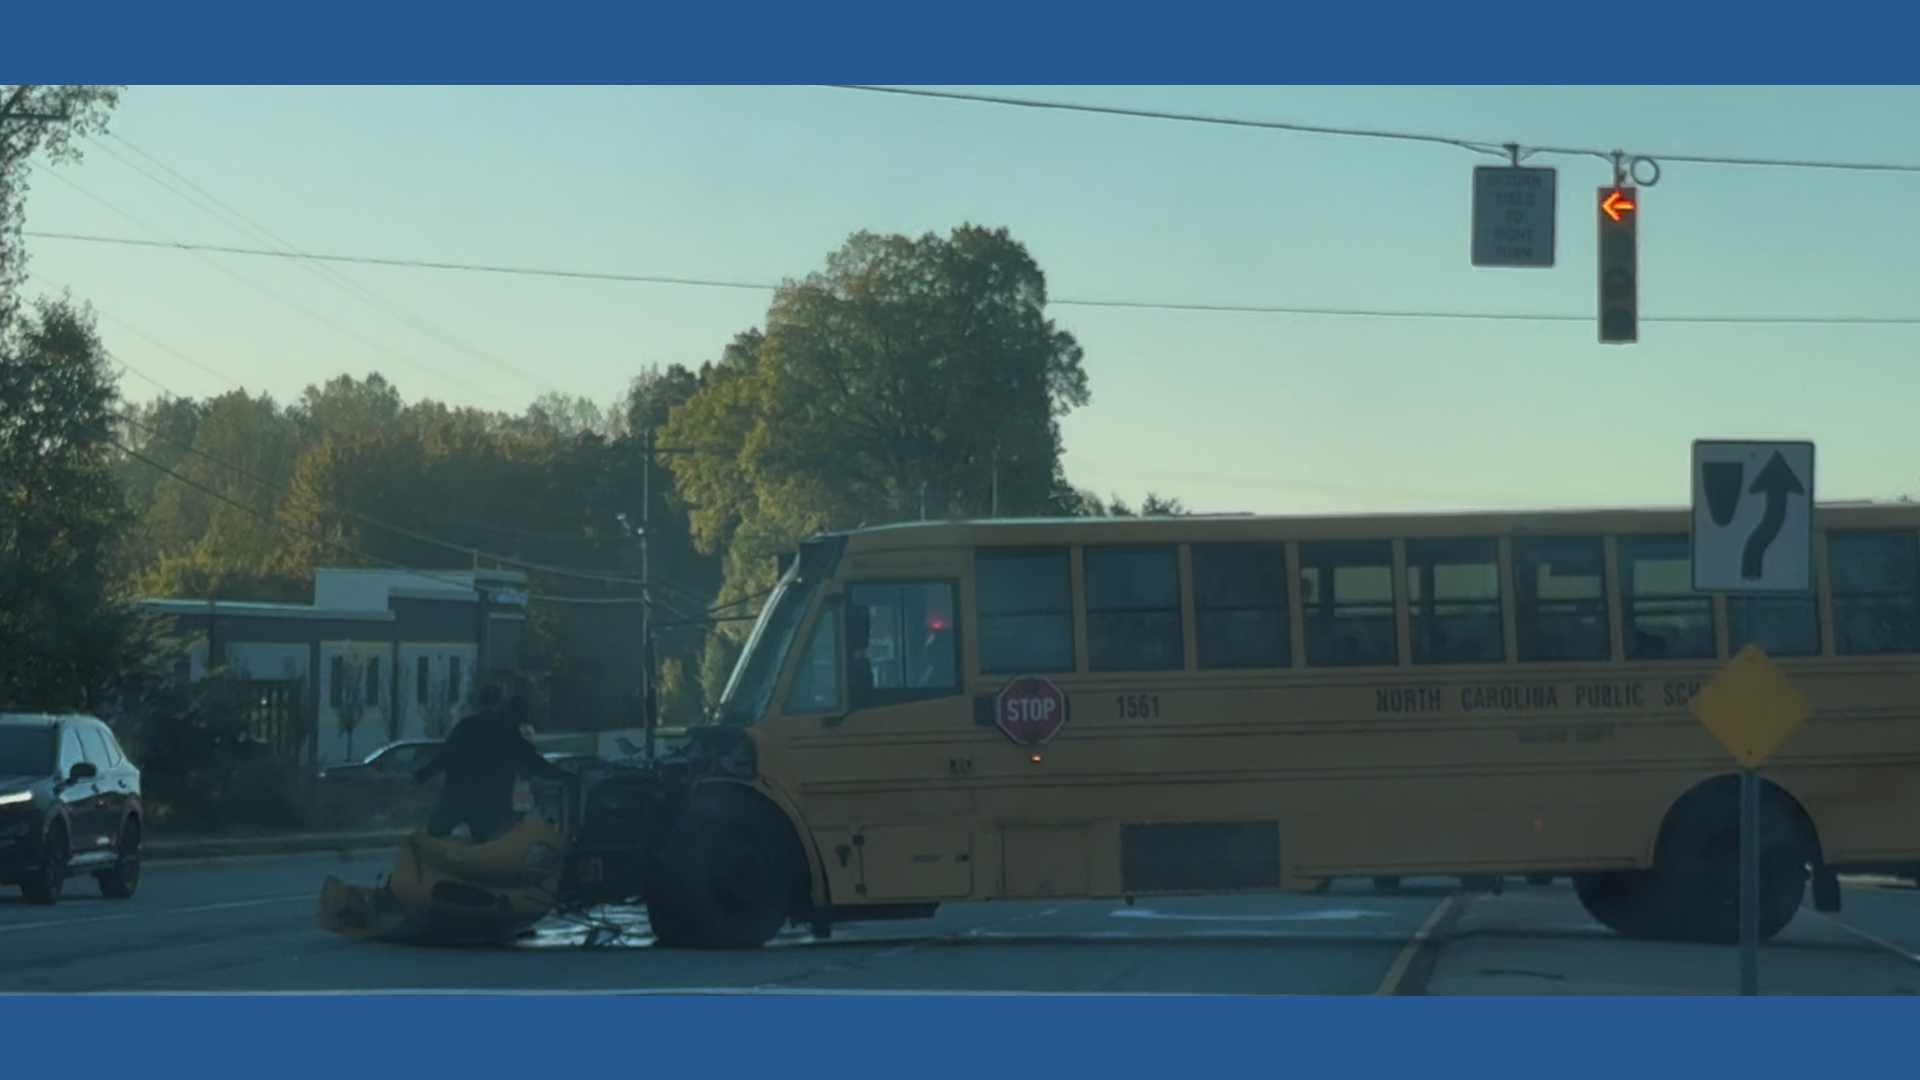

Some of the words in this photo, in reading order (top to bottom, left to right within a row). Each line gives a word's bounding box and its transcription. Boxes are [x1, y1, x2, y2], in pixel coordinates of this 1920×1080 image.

[1507, 208, 1523, 224] TO
[1496, 245, 1533, 258] TURN
[1007, 697, 1056, 722] STOP
[1116, 694, 1159, 718] 1561
[1375, 688, 1441, 713] NORTH
[1461, 685, 1558, 711] CAROLINA
[1575, 683, 1644, 708] PUBLIC
